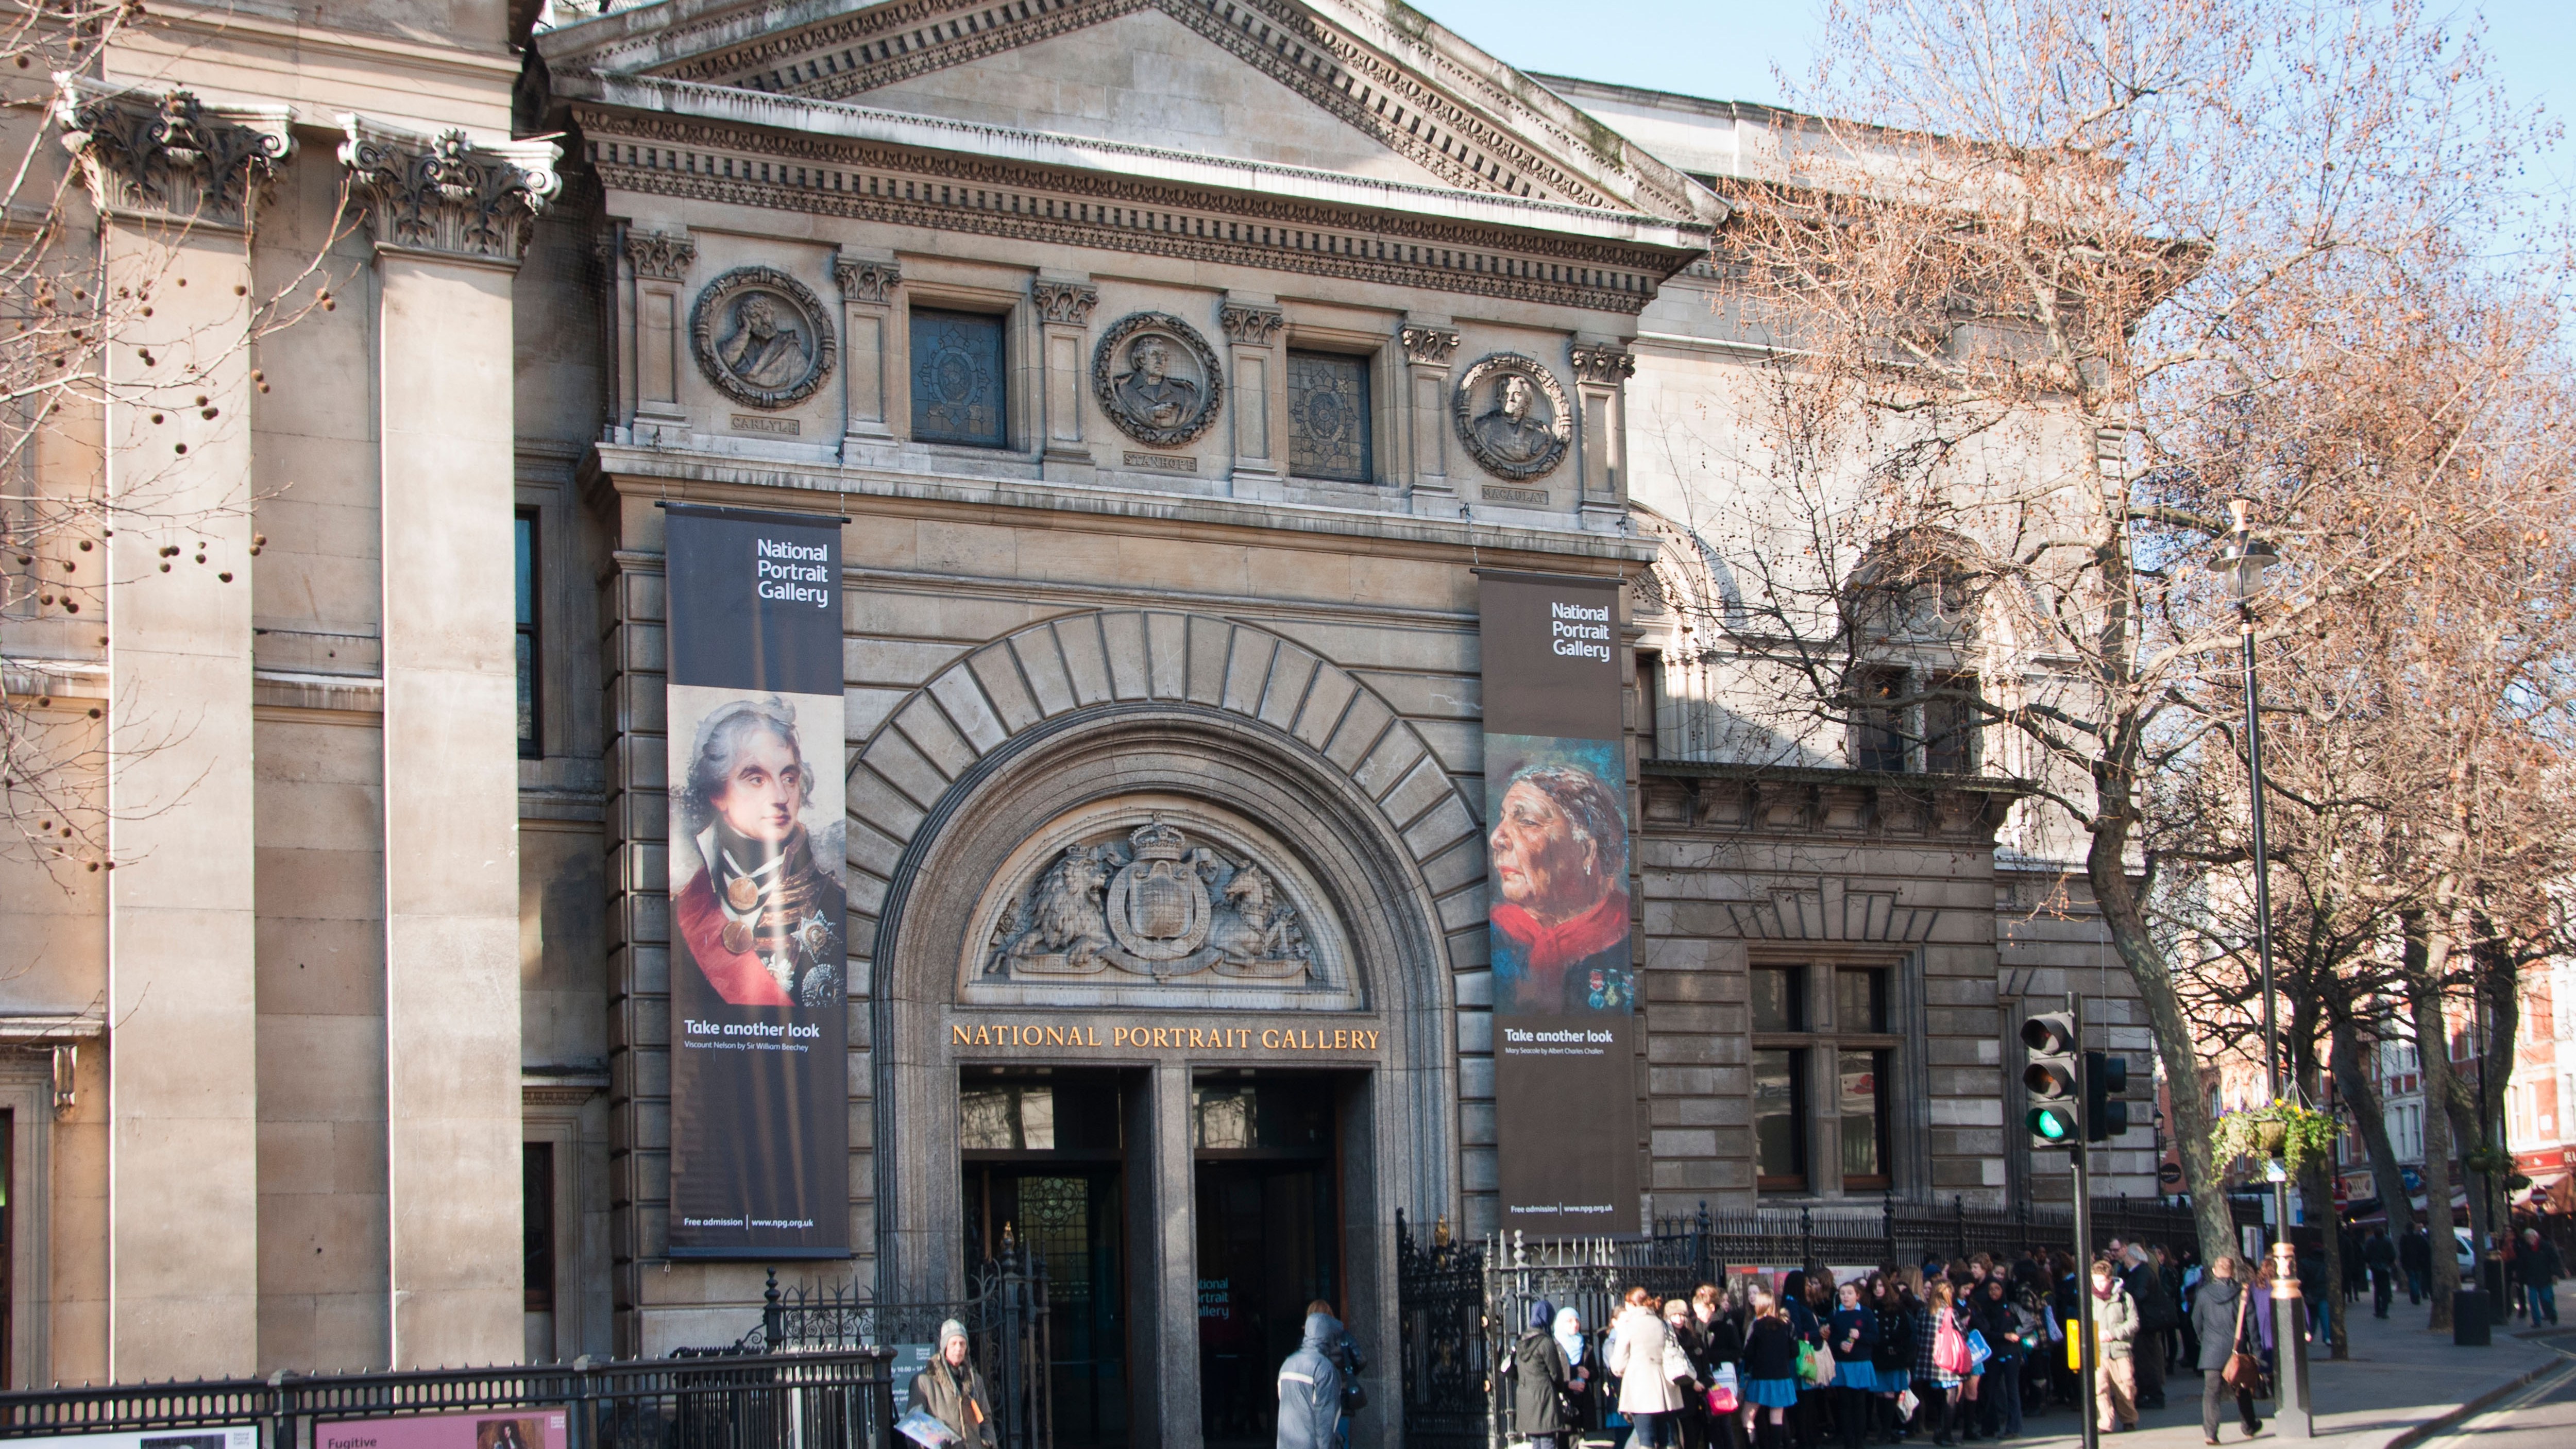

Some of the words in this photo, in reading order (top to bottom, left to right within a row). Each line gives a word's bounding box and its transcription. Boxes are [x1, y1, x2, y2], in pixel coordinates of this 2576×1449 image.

[732, 417, 797, 434] CARLYLE
[1124, 453, 1195, 471] STANHOPE
[1482, 487, 1545, 503] MACAULAY
[758, 538, 827, 562] National
[758, 559, 828, 583] Portrait
[758, 580, 828, 608] Gallery
[1552, 602, 1608, 622] National
[1552, 620, 1610, 640] Portrait
[1553, 639, 1611, 662] Gallery
[684, 1019, 720, 1035] Take
[724, 1022, 785, 1036] another
[788, 1022, 820, 1037] look
[1504, 1029, 1534, 1042] Take
[1536, 1029, 1585, 1043] another
[1587, 1030, 1613, 1043] look
[952, 1024, 1103, 1047] NATIONAL
[1113, 1027, 1252, 1049] PORTRAIT
[1261, 1029, 1380, 1050] GALLERY
[684, 1041, 713, 1049] Viscount
[714, 1041, 736, 1049] Nelson
[737, 1042, 746, 1051] by
[756, 1042, 781, 1050] William
[782, 1043, 809, 1052] Beechey
[1564, 1204, 1613, 1214] www.npg.org.uk
[684, 1217, 701, 1226] Free
[703, 1217, 743, 1226] admission
[751, 1218, 814, 1229] www.npg.org.uk
[1198, 1277, 1229, 1289] tional
[1198, 1292, 1229, 1303] rtrait
[1198, 1305, 1229, 1320] allery
[328, 1437, 377, 1449] Fugitive
